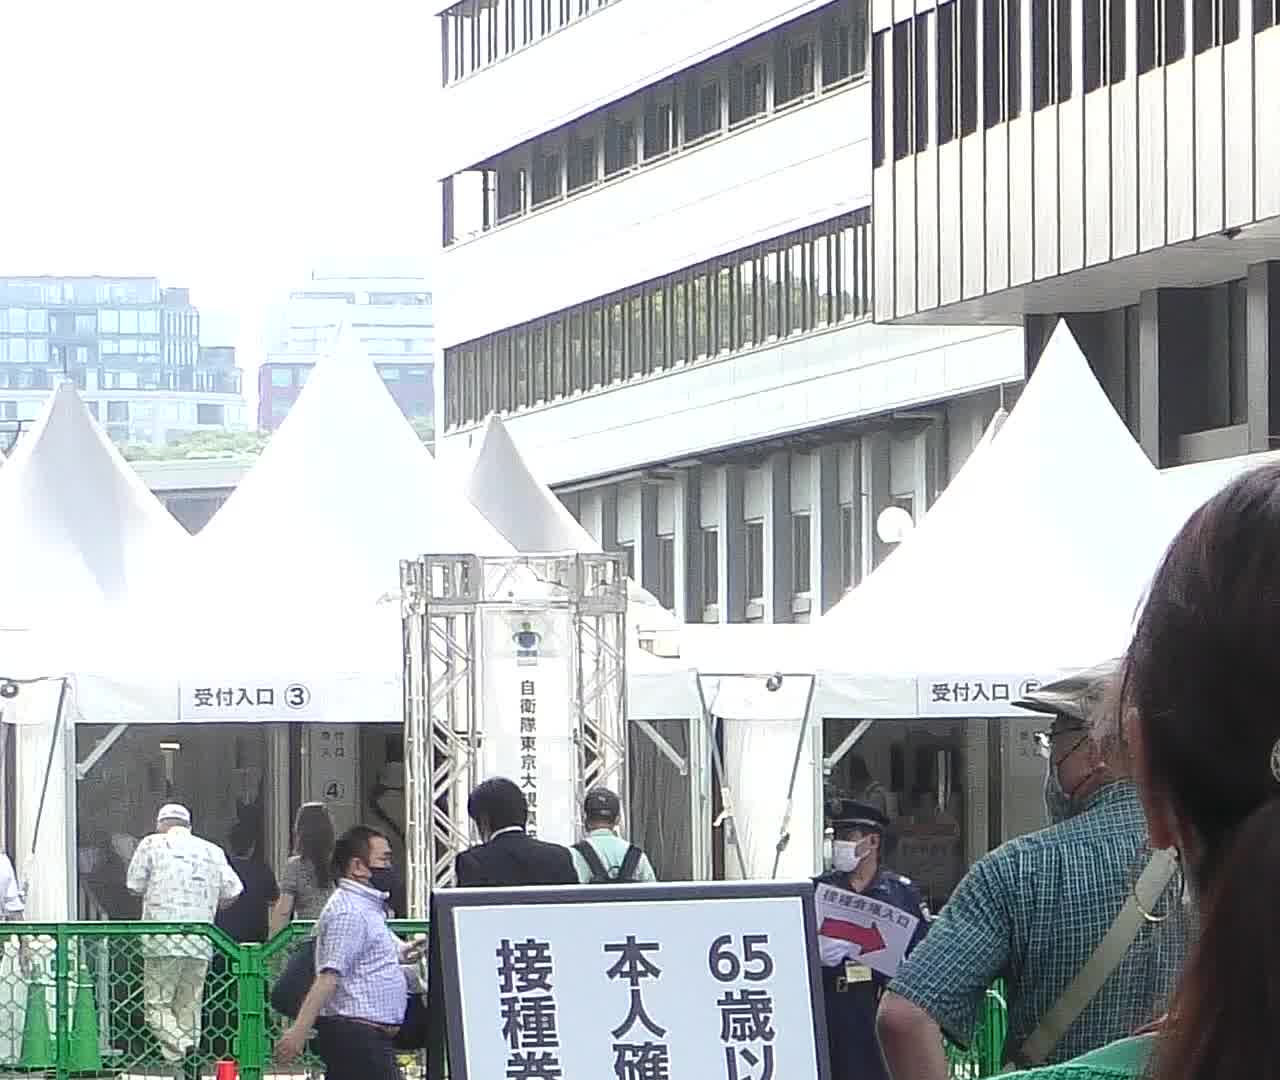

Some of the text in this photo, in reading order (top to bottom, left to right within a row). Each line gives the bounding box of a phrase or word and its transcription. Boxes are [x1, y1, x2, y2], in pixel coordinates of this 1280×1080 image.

[193, 687, 275, 708] 受付入口
[931, 682, 1010, 703] 受付入口
